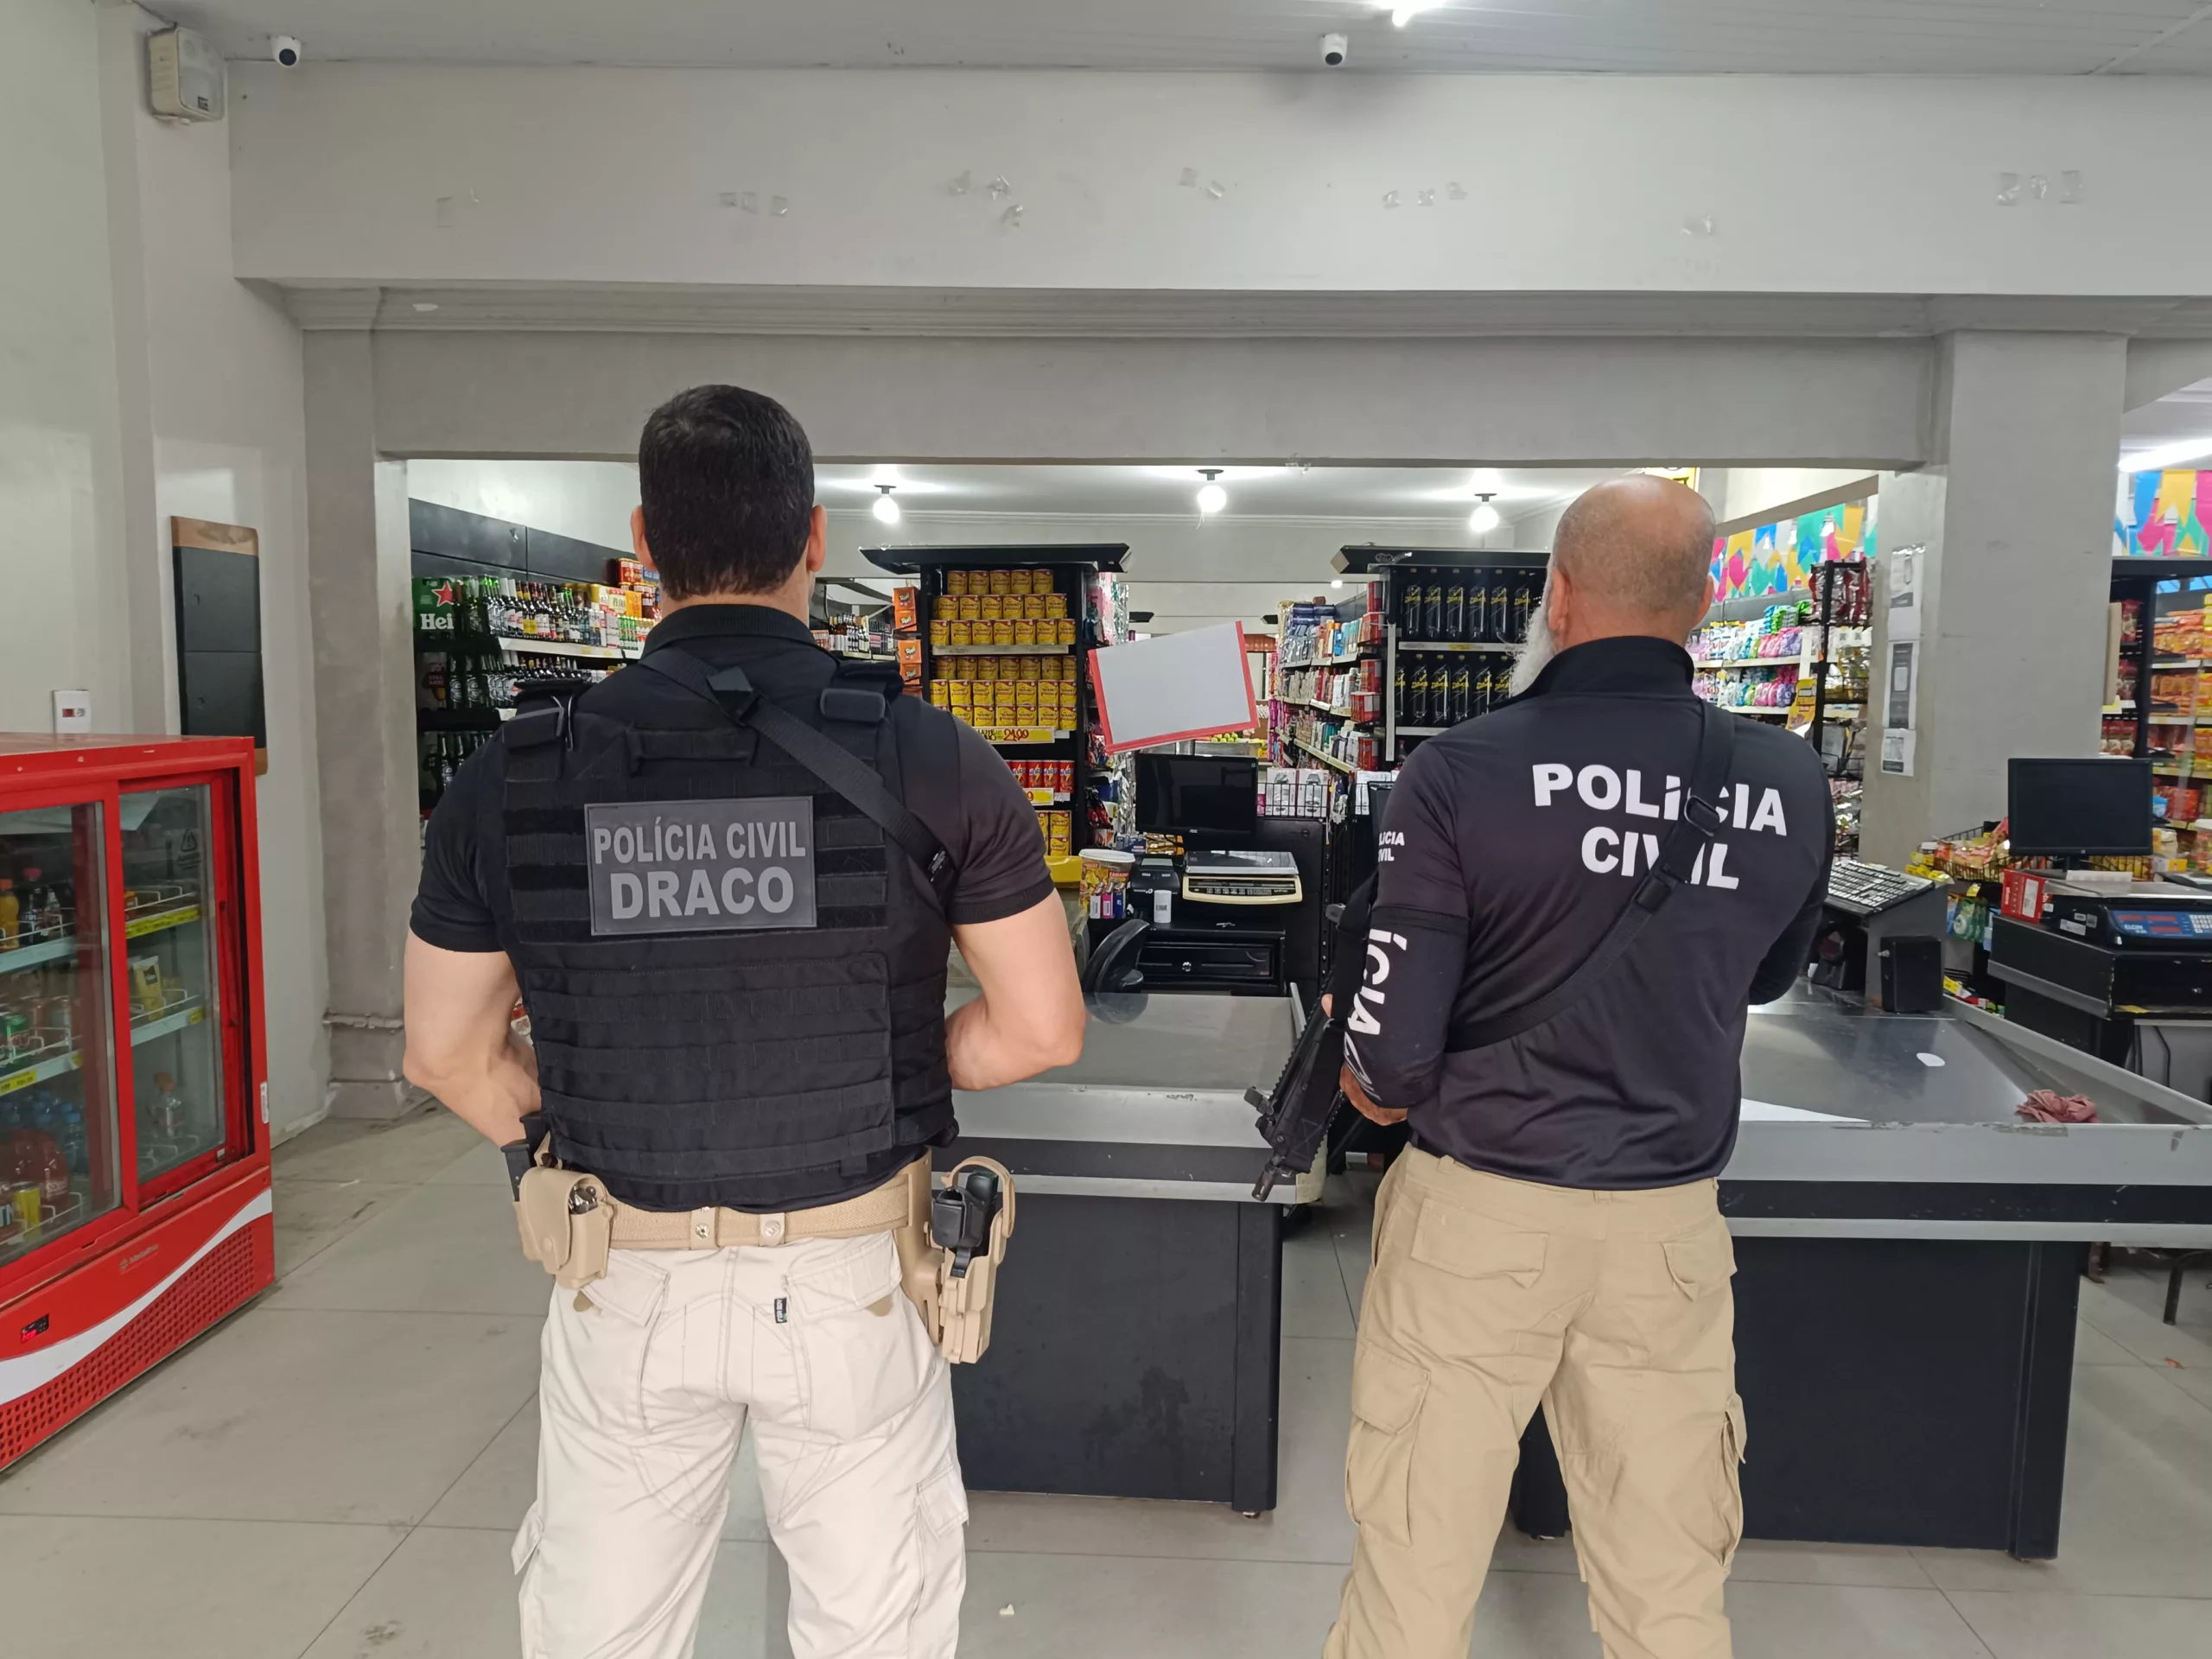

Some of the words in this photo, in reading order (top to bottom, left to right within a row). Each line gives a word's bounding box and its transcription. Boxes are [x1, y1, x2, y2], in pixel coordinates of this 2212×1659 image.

[594, 817, 717, 864] POLÍCIA
[727, 822, 806, 859] CIVIL
[610, 867, 794, 919] DRACO
